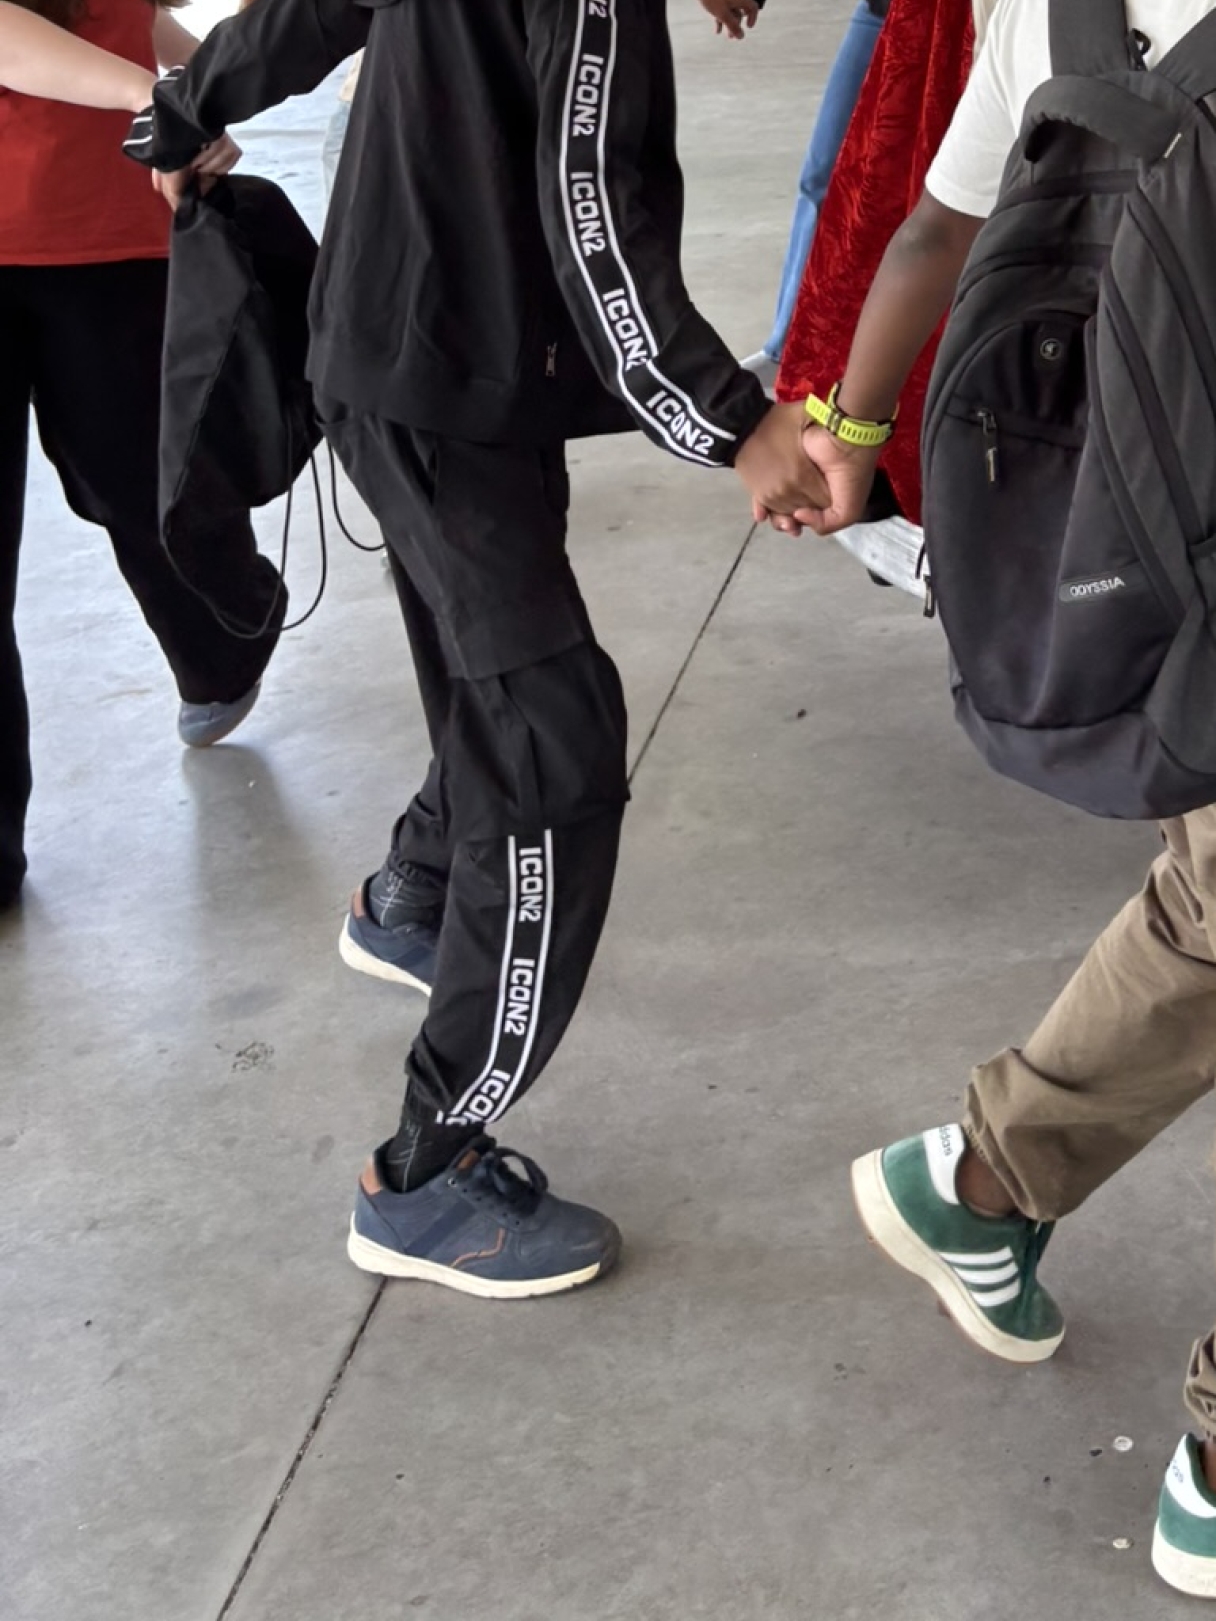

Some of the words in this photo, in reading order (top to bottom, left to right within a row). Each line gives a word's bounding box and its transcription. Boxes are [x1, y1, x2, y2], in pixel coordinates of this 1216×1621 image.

[572, 53, 605, 137] ICON2
[570, 171, 607, 257] ICON2
[645, 390, 715, 456] ICON2
[1069, 576, 1126, 597] ODYSSIA
[518, 846, 543, 923] ICON2
[504, 958, 535, 1037] ICON2
